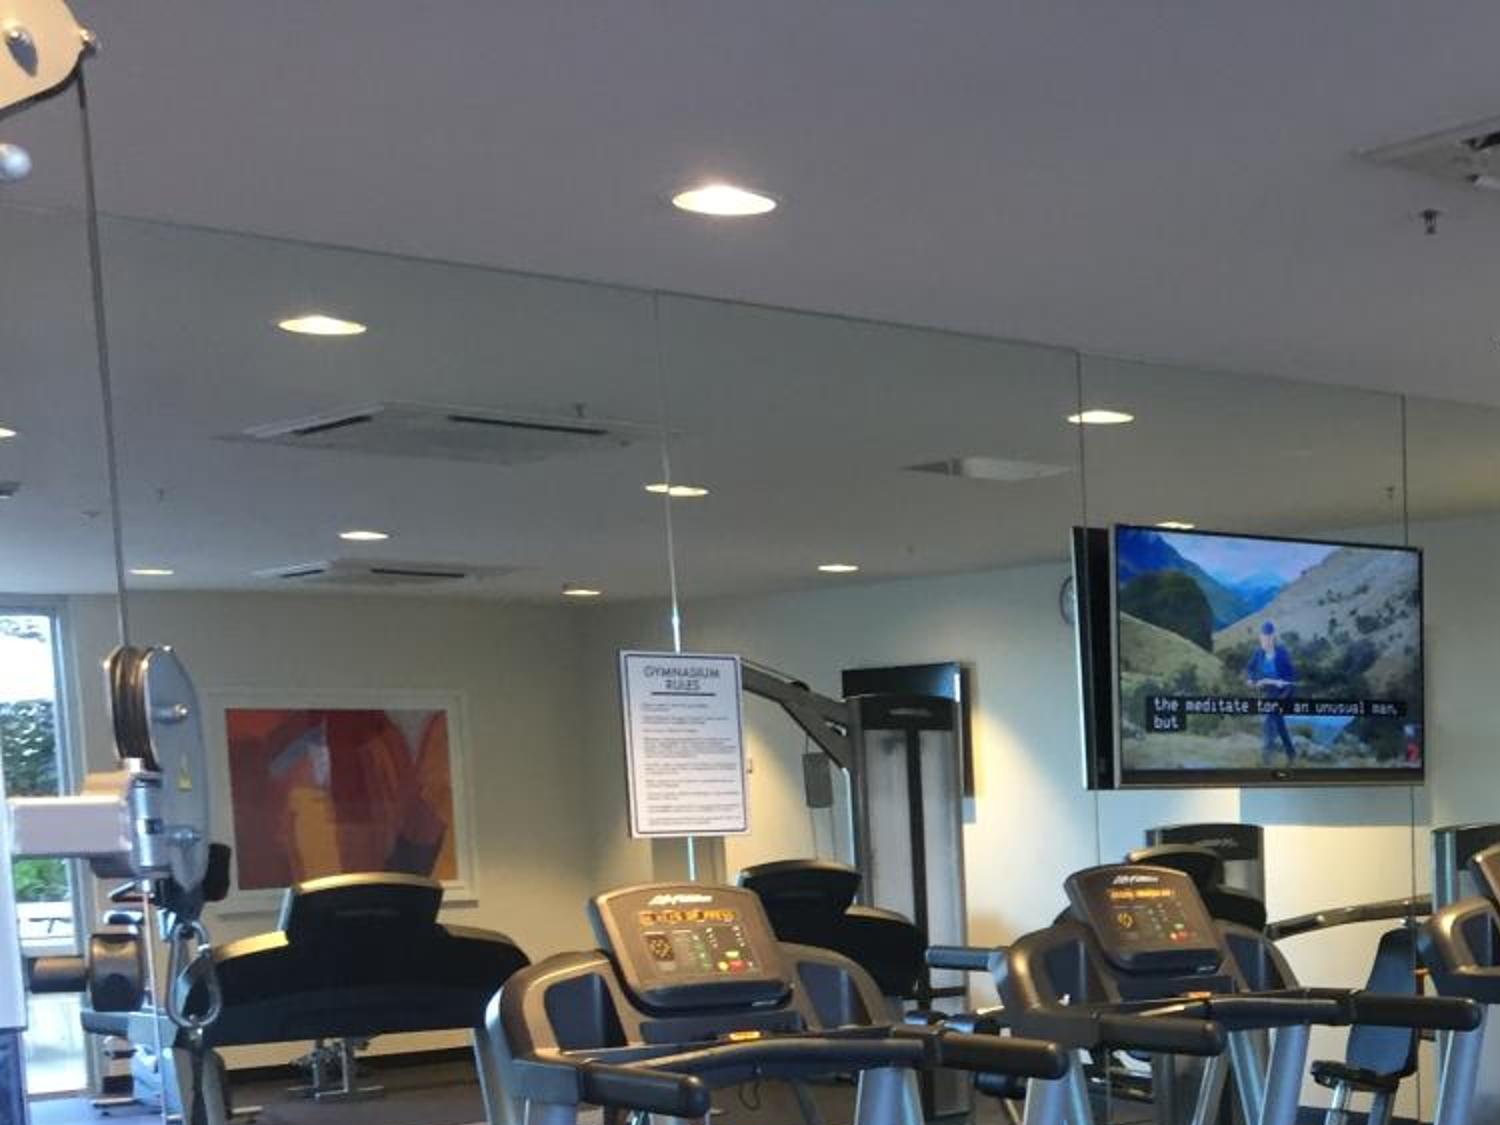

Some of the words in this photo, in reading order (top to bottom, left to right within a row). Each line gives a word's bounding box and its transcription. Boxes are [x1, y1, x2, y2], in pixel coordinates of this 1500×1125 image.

[642, 664, 720, 679] GYMNASIUM
[664, 679, 701, 691] RULES
[1154, 696, 1179, 712] the
[1153, 714, 1179, 729] but
